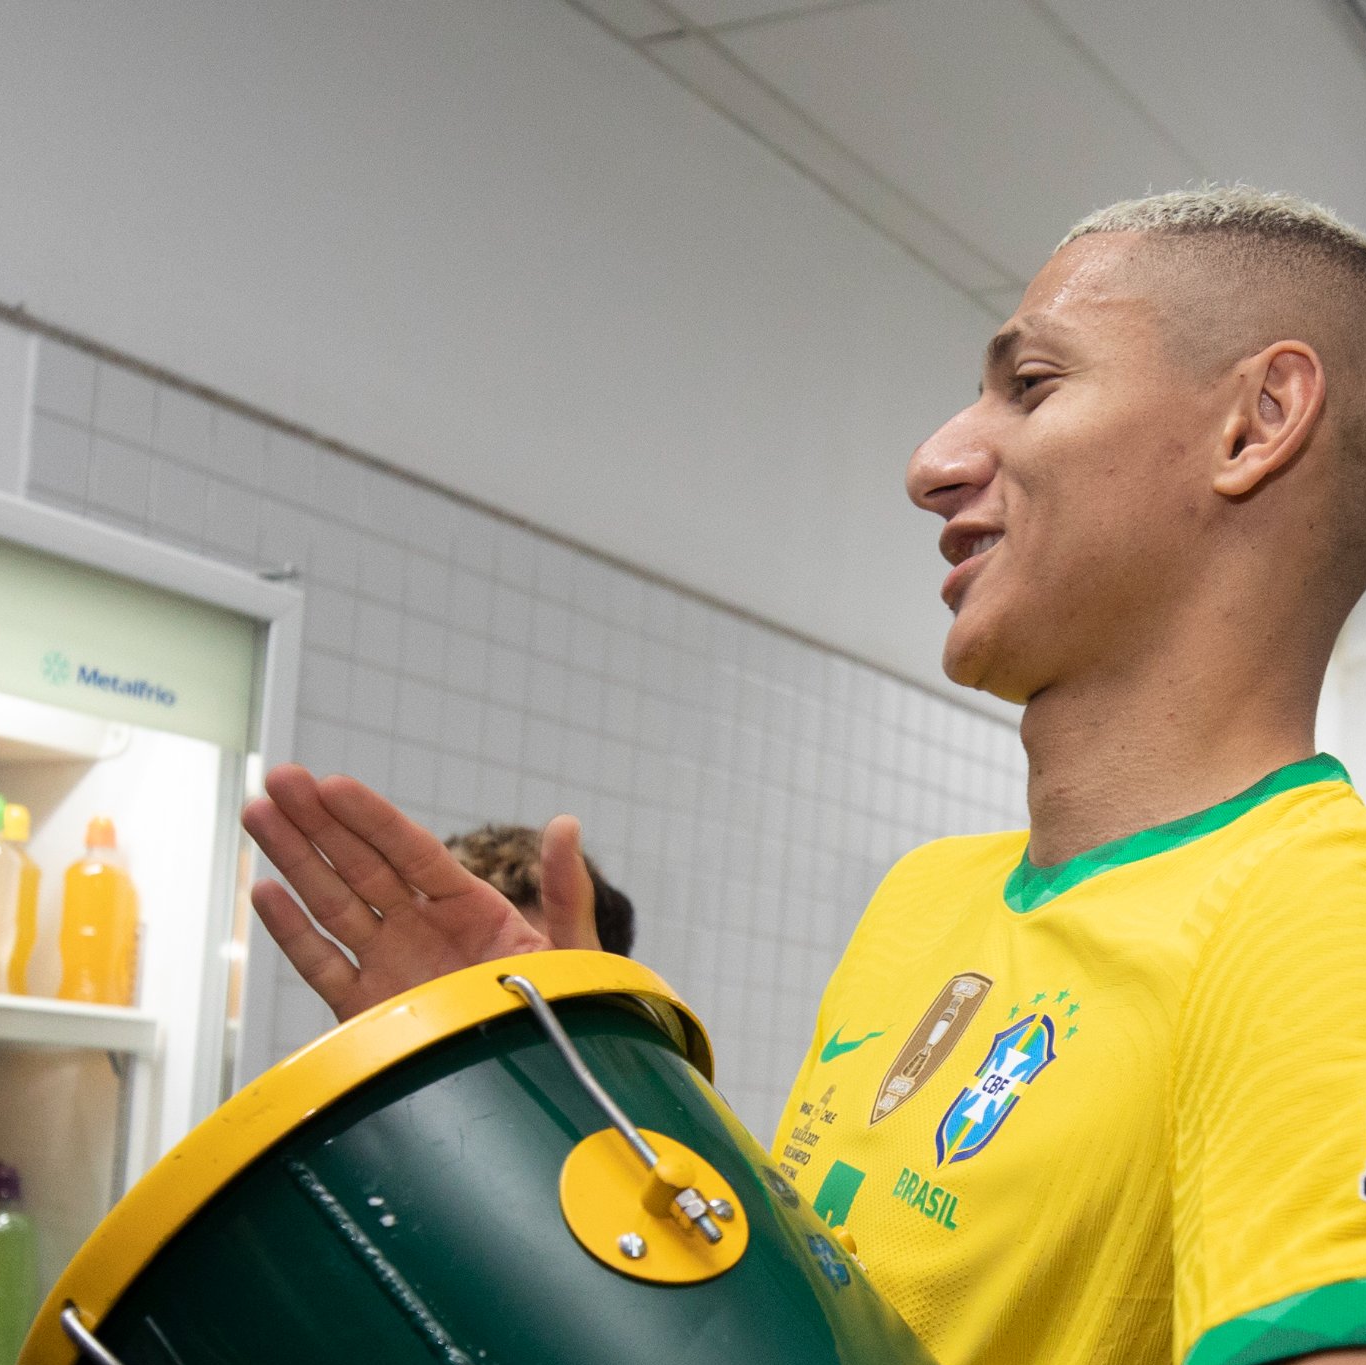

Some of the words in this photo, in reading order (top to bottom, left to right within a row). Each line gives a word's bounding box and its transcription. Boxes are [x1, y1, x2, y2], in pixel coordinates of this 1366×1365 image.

[77, 664, 177, 707] Metalfrio
[981, 1073, 1012, 1097] CBF
[892, 1167, 959, 1231] BRASIL
